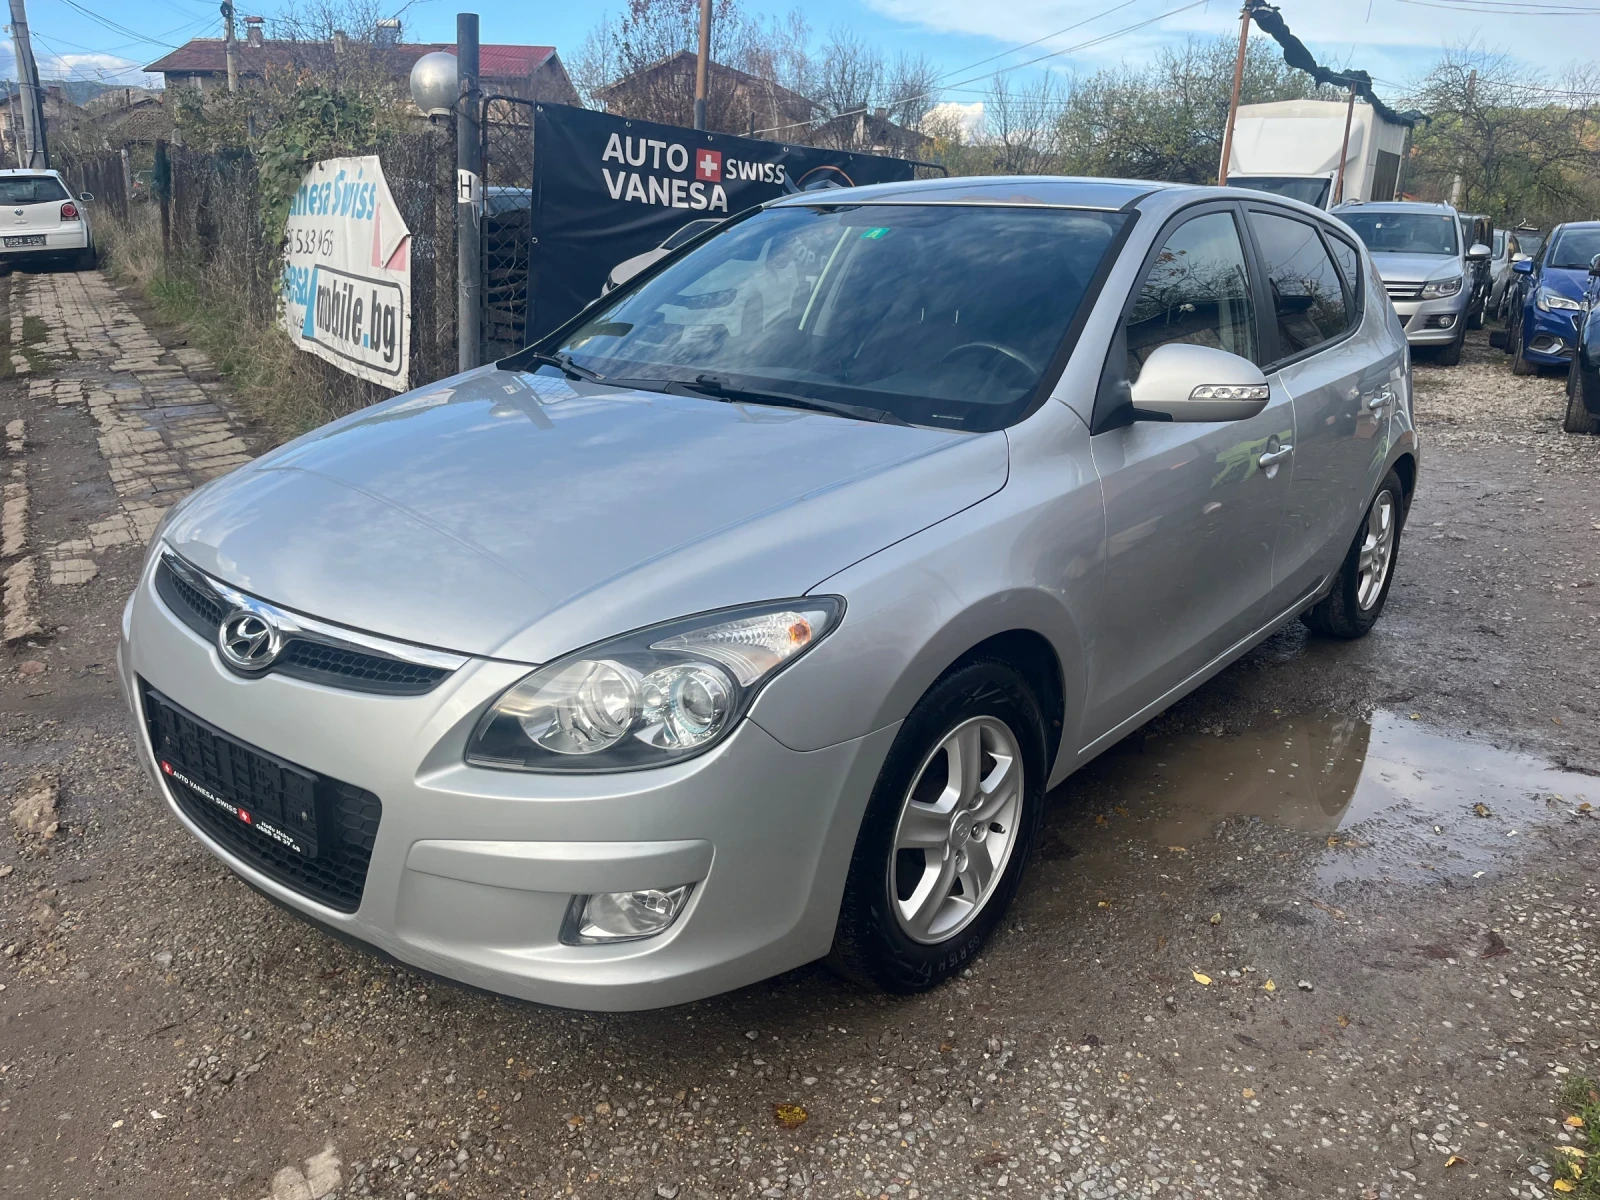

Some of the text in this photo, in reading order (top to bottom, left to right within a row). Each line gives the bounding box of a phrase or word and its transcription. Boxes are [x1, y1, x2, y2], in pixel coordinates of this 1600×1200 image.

[602, 132, 689, 173] AUTO
[726, 158, 785, 185] SWISS
[332, 167, 376, 220] Swiss
[602, 168, 728, 213] VANESA
[285, 264, 309, 306] esa
[316, 279, 396, 363] mobile.bg
[173, 770, 238, 814] AUTO VANESA SWISS
